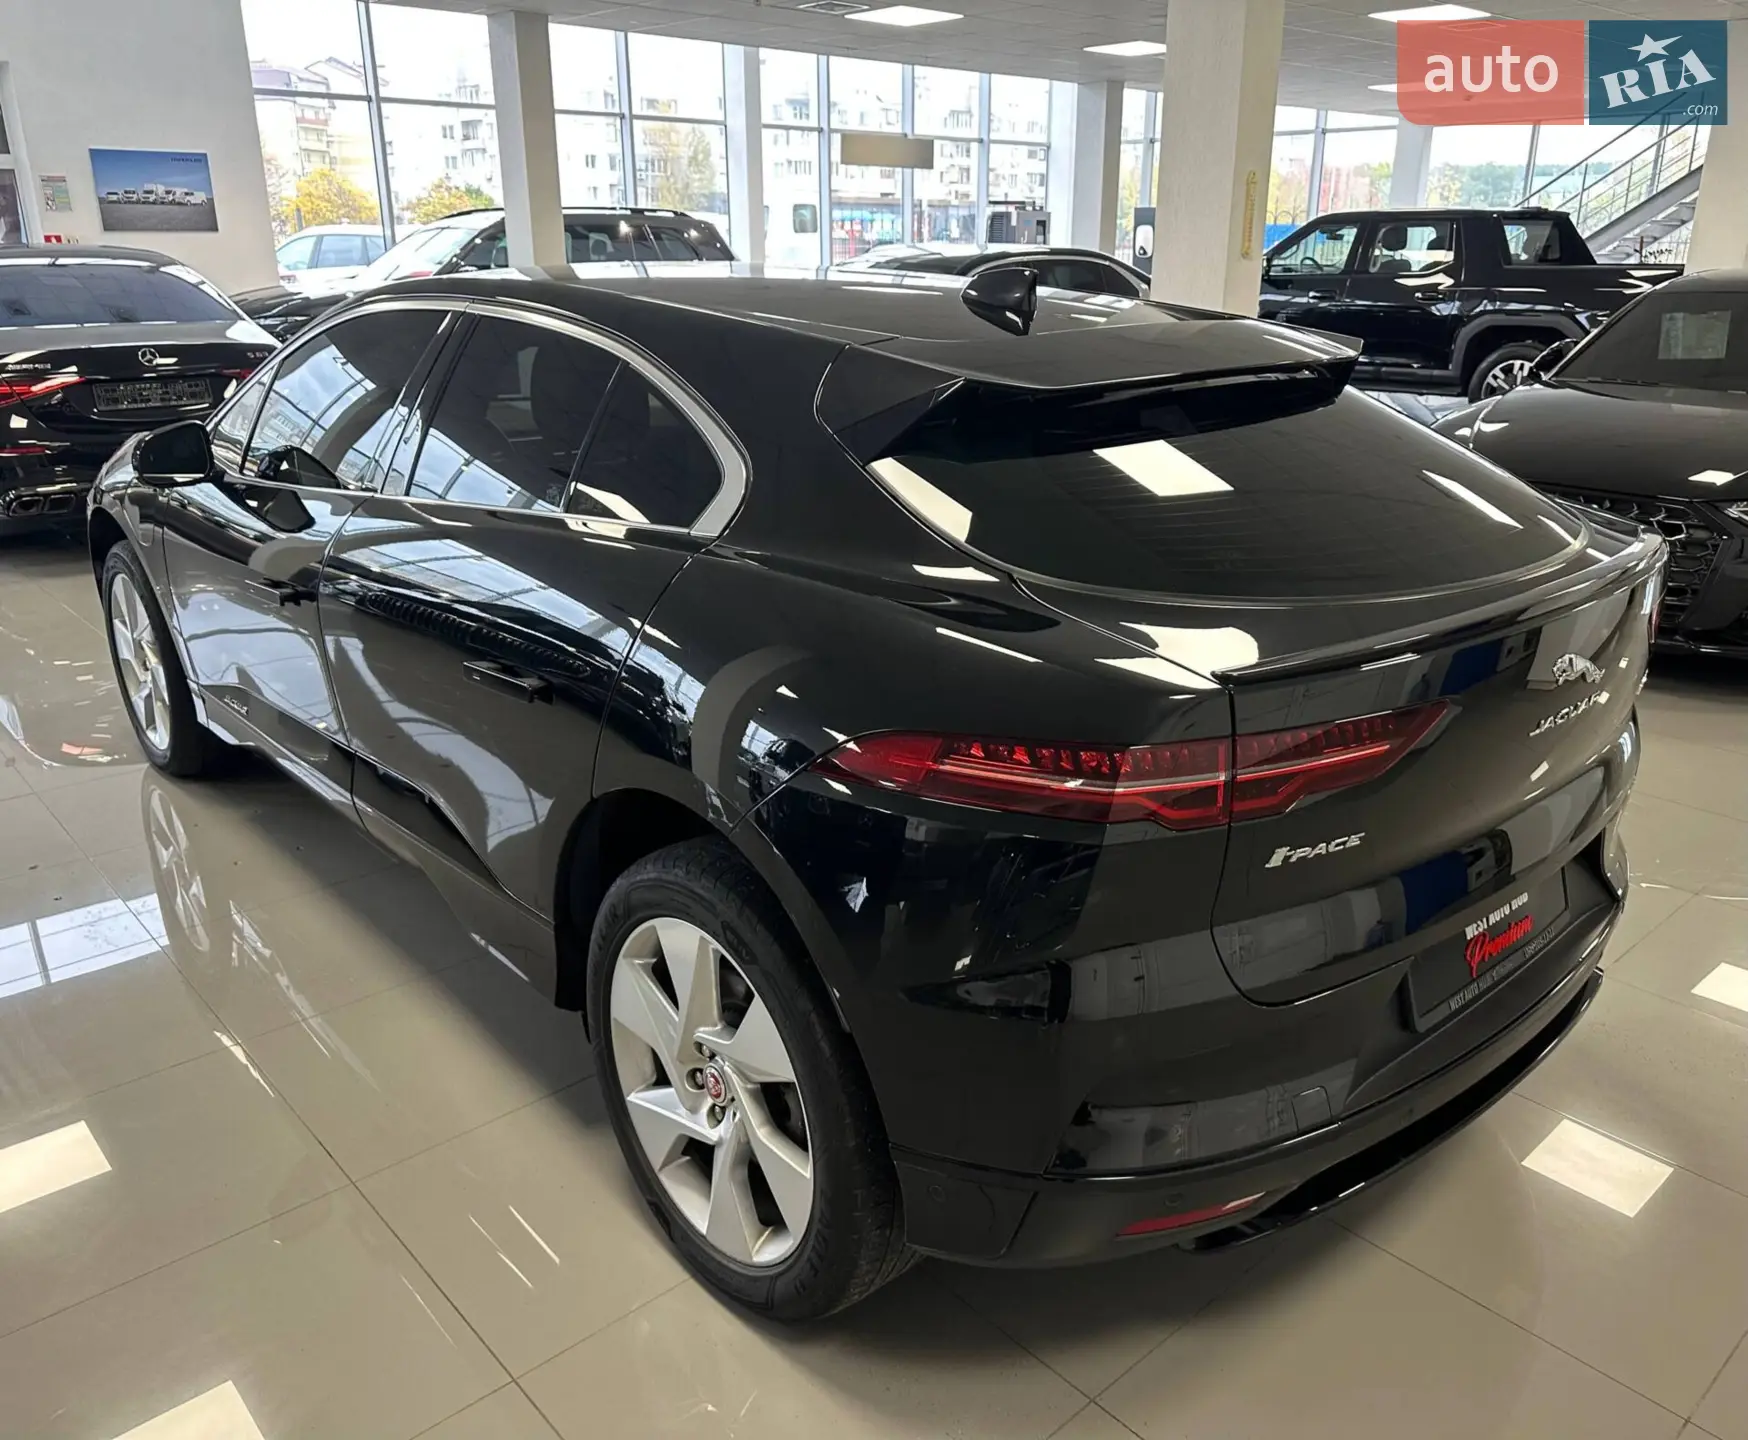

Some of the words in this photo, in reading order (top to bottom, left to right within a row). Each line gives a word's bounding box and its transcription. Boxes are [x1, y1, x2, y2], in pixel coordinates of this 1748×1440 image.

[1464, 917, 1488, 940] WEST
[1488, 903, 1511, 926] AUTO
[1464, 913, 1533, 978] Premium
